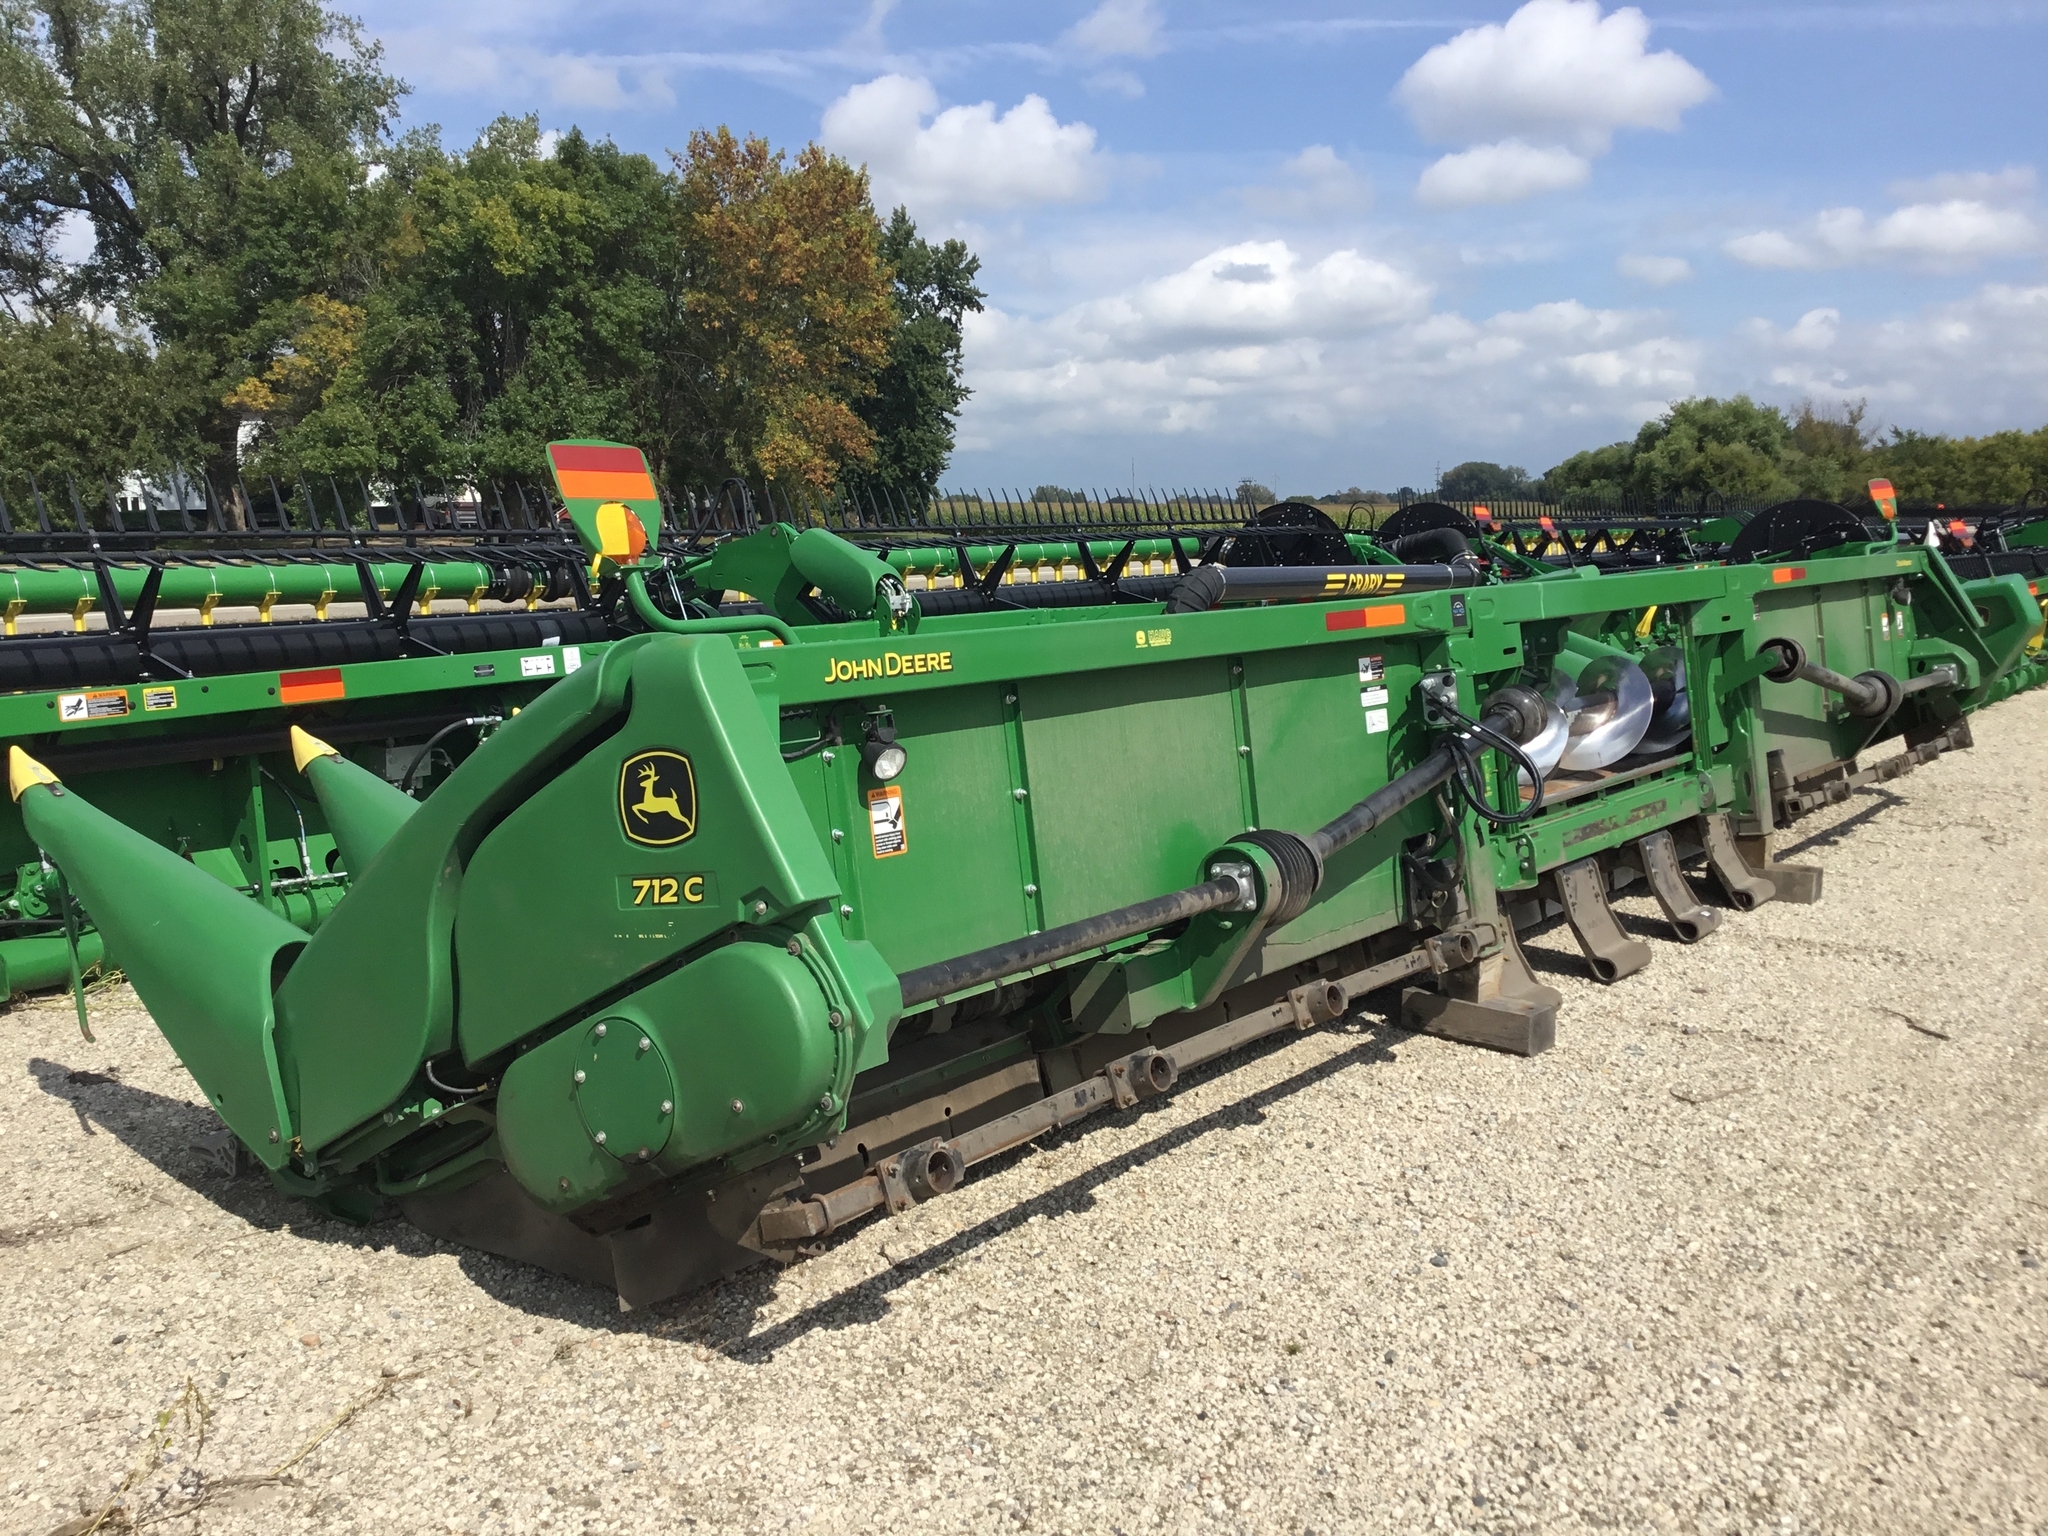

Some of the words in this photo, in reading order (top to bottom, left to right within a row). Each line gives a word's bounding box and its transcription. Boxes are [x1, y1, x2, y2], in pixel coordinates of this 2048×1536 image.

[1344, 573, 1383, 595] CRARY
[824, 657, 883, 684] JOHN
[884, 651, 953, 677] DEERE
[631, 876, 679, 906] 712
[683, 875, 704, 903] C
